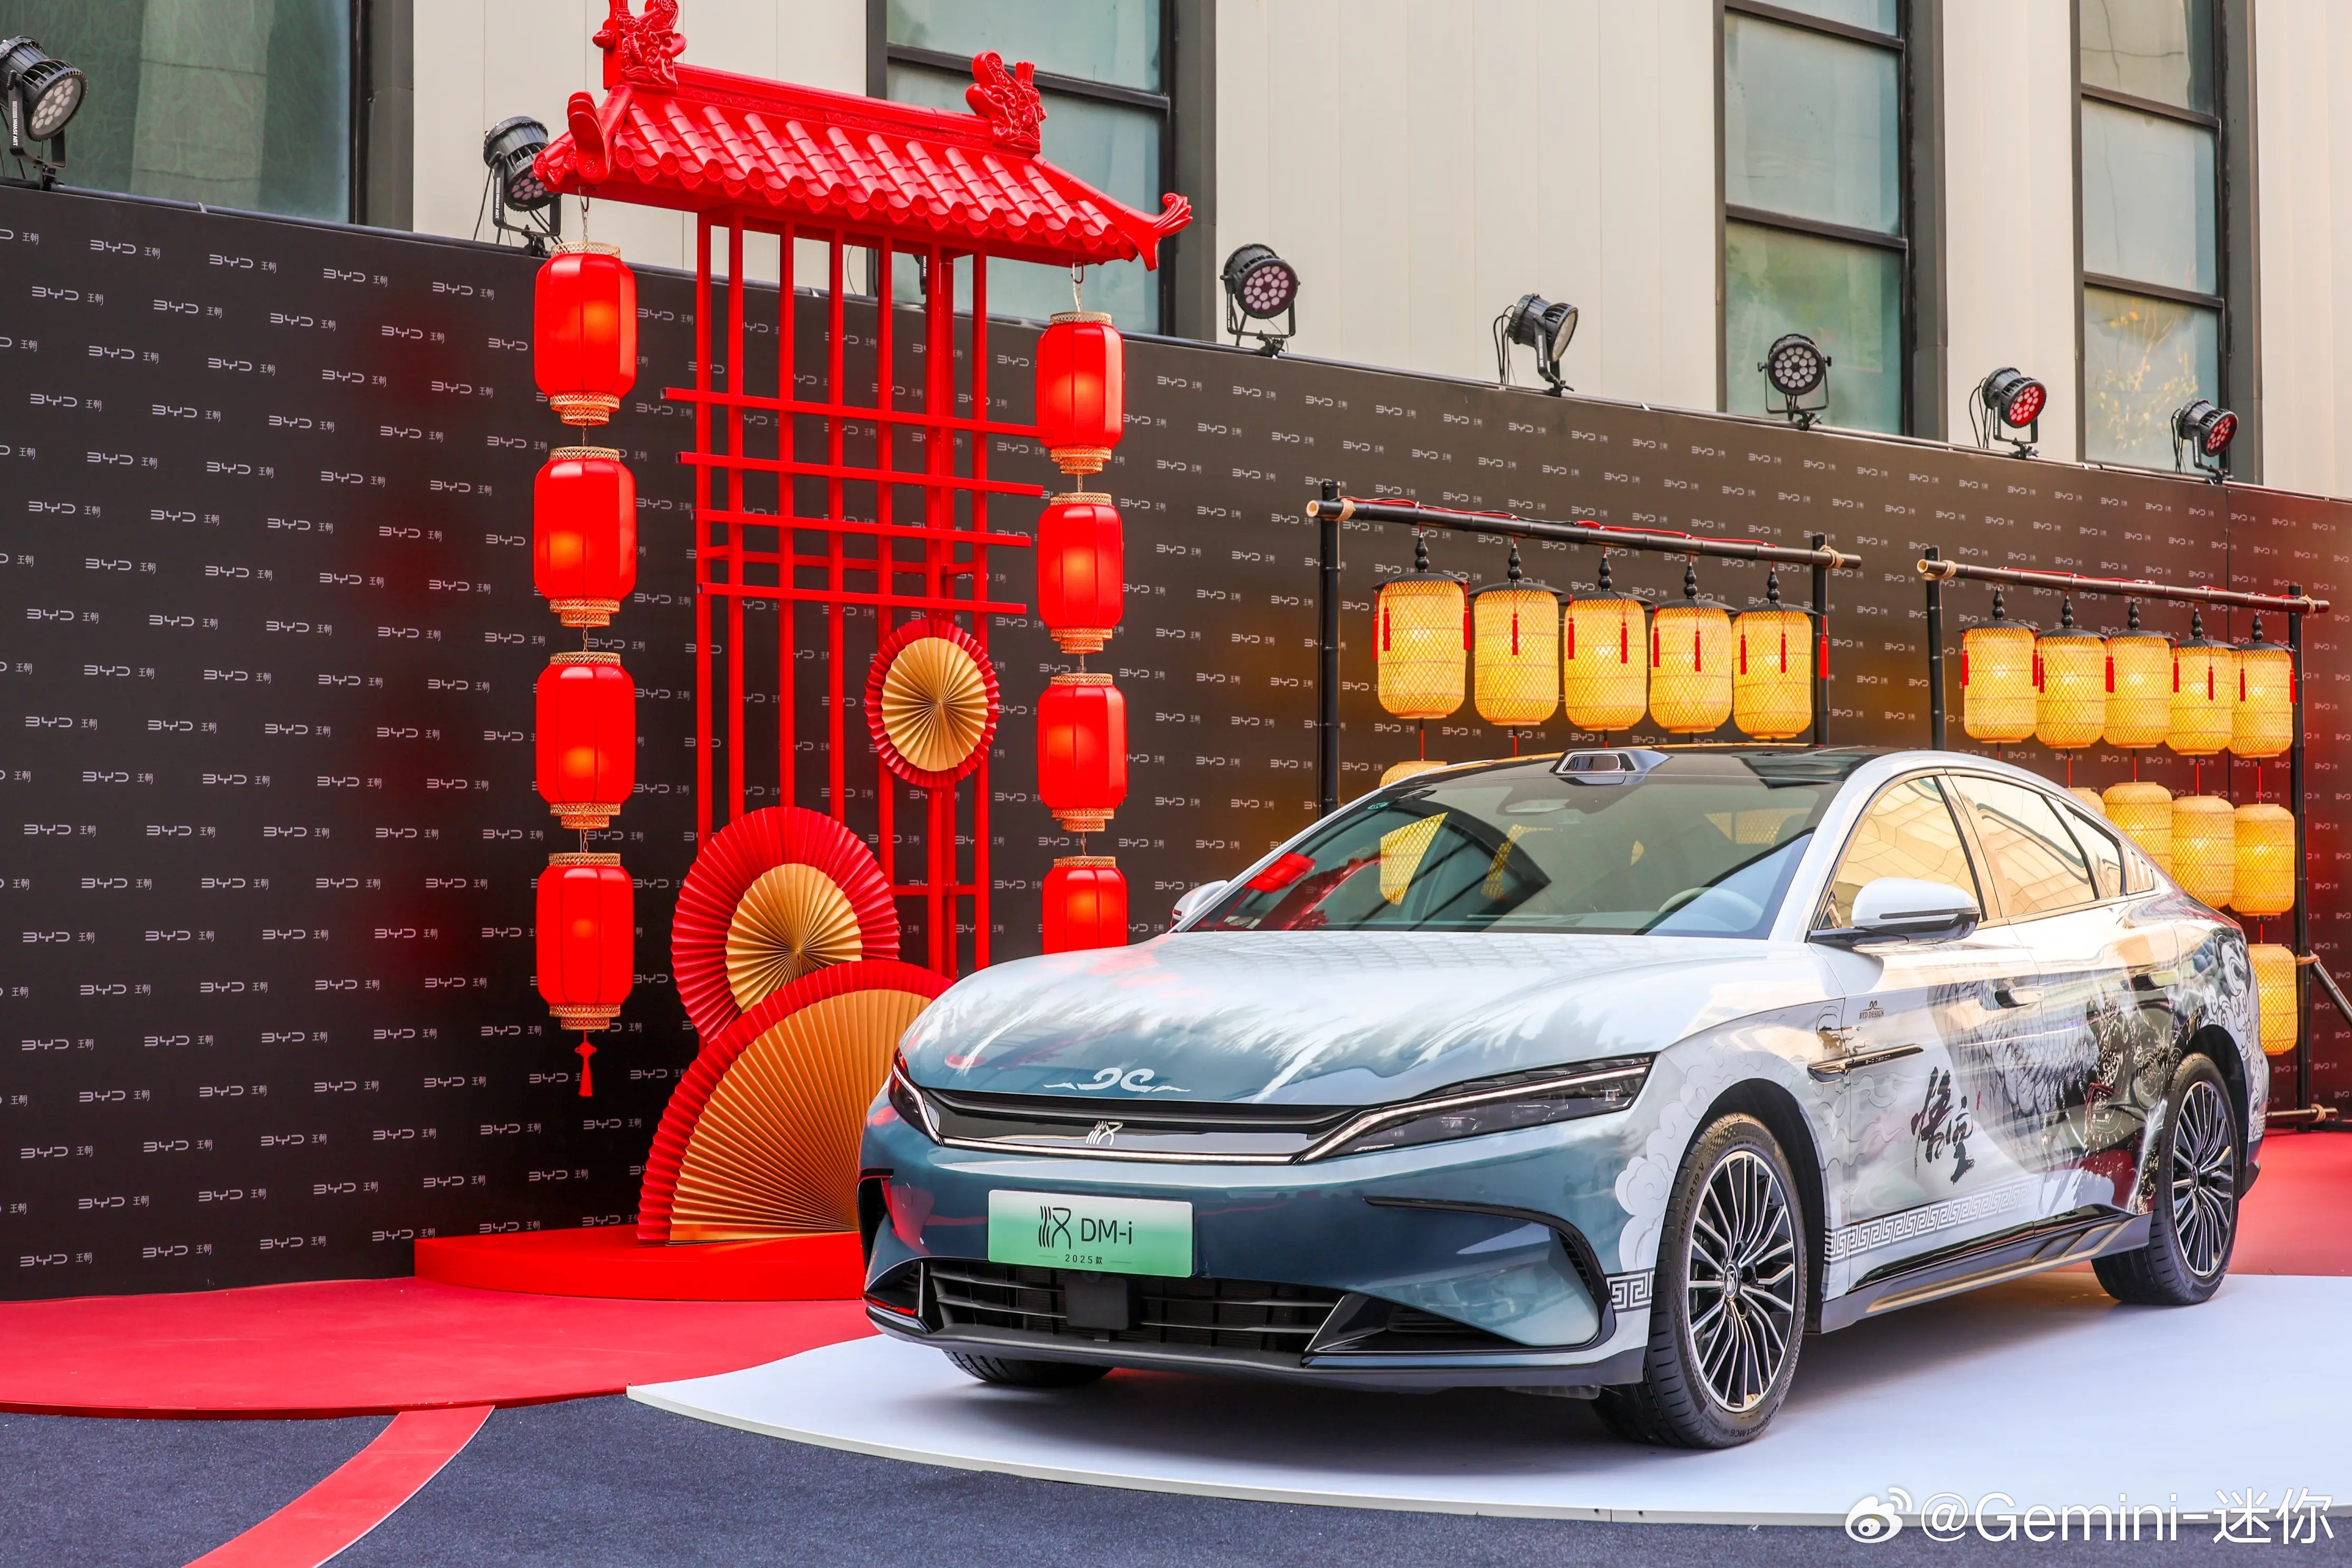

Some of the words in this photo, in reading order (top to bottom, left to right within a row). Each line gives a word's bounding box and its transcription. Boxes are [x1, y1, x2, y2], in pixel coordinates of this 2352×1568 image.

[90, 239, 136, 254] BYD
[144, 247, 160, 259] 王朝
[32, 286, 79, 301] BYD
[87, 293, 104, 306] 王朝
[322, 369, 365, 383] BYD
[372, 375, 386, 387] 王朝
[432, 380, 472, 394] BYD
[479, 386, 493, 398] 王朝
[1306, 395, 1333, 406] BYD
[152, 404, 197, 418] BYD
[205, 410, 221, 422] 王朝
[1443, 413, 1469, 424] BYD
[269, 415, 312, 428] BYD
[319, 420, 335, 433] 王朝
[380, 426, 422, 438] BYD
[429, 431, 443, 443] 王朝
[87, 452, 133, 465] BYD
[141, 457, 157, 469] 王朝
[1478, 457, 1503, 467] BYD
[1232, 468, 1261, 479] BYD
[28, 501, 76, 514] BYD
[84, 506, 101, 517] 王朝
[1120, 498, 1150, 509] BYD
[1197, 506, 1226, 516] BYD
[1342, 521, 1369, 531] BYD
[1156, 544, 1186, 554] BYD
[319, 572, 362, 584] BYD
[369, 576, 384, 587] 王朝
[429, 579, 469, 591] BYD
[476, 583, 491, 594] 王朝
[634, 592, 671, 604] BYD
[1271, 595, 1299, 605] BYD
[149, 614, 194, 626] BYD
[202, 618, 218, 630] 王朝
[266, 620, 309, 632] BYD
[317, 624, 331, 635] 王朝
[996, 616, 1027, 627] BYD
[378, 626, 419, 638] BYD
[427, 630, 441, 641] 王朝
[84, 664, 130, 677] BYD
[139, 668, 154, 679] 王朝
[25, 716, 73, 728] BYD
[81, 719, 97, 730] 王朝
[1231, 716, 1260, 726] BYD
[377, 727, 418, 738] BYD
[426, 729, 440, 740] 王朝
[1196, 756, 1225, 765] BYD
[317, 776, 360, 787] BYD
[367, 778, 381, 789] 王朝
[427, 778, 467, 789] BYD
[475, 780, 488, 791] 王朝
[632, 783, 670, 793] BYD
[1155, 797, 1184, 806] BYD
[146, 825, 192, 836] BYD
[200, 826, 215, 838] 王朝
[263, 826, 307, 837] BYD
[315, 828, 329, 839] 王朝
[483, 829, 523, 839] BYD
[530, 830, 543, 841] 王朝
[1119, 838, 1149, 847] BYD
[81, 878, 128, 888] BYD
[136, 878, 152, 890] 王朝
[994, 880, 1026, 889] BYD
[23, 932, 70, 942] BYD
[79, 932, 95, 943] 王朝
[375, 928, 416, 938] BYD
[424, 928, 438, 939] 王朝
[315, 979, 357, 990] BYD
[365, 979, 379, 991] 王朝
[425, 977, 466, 988] BYD
[473, 977, 486, 988] 王朝
[1868, 1010, 1884, 1018] DESIGN
[144, 1035, 190, 1046] BYD
[198, 1035, 213, 1046] 王朝
[262, 1032, 305, 1043] BYD
[312, 1031, 328, 1043] 王朝
[79, 1090, 126, 1102] BYD
[134, 1090, 150, 1101] 王朝
[481, 1123, 521, 1135] BYD
[527, 1123, 541, 1133] 王朝
[583, 1119, 622, 1130] BYD
[373, 1129, 415, 1140] BYD
[422, 1128, 436, 1139] 王朝
[21, 1146, 68, 1159] BYD
[77, 1145, 93, 1157] 王朝
[424, 1175, 464, 1188] BYD
[471, 1175, 485, 1185] 王朝
[528, 1170, 568, 1181] BYD
[313, 1182, 356, 1194] BYD
[363, 1181, 378, 1192] 王朝
[78, 1196, 125, 1209] BYD
[133, 1195, 149, 1207] 王朝
[1679, 1199, 1692, 1244] 245/45
[1689, 1189, 1695, 1197] R
[1693, 1173, 1700, 1188] 19
[1081, 1218, 1133, 1246] DM-i
[260, 1237, 303, 1249] BYD
[311, 1236, 326, 1247] 王朝
[142, 1245, 188, 1258] BYD
[196, 1243, 212, 1255] 王朝
[1065, 1254, 1103, 1265] 2025款
